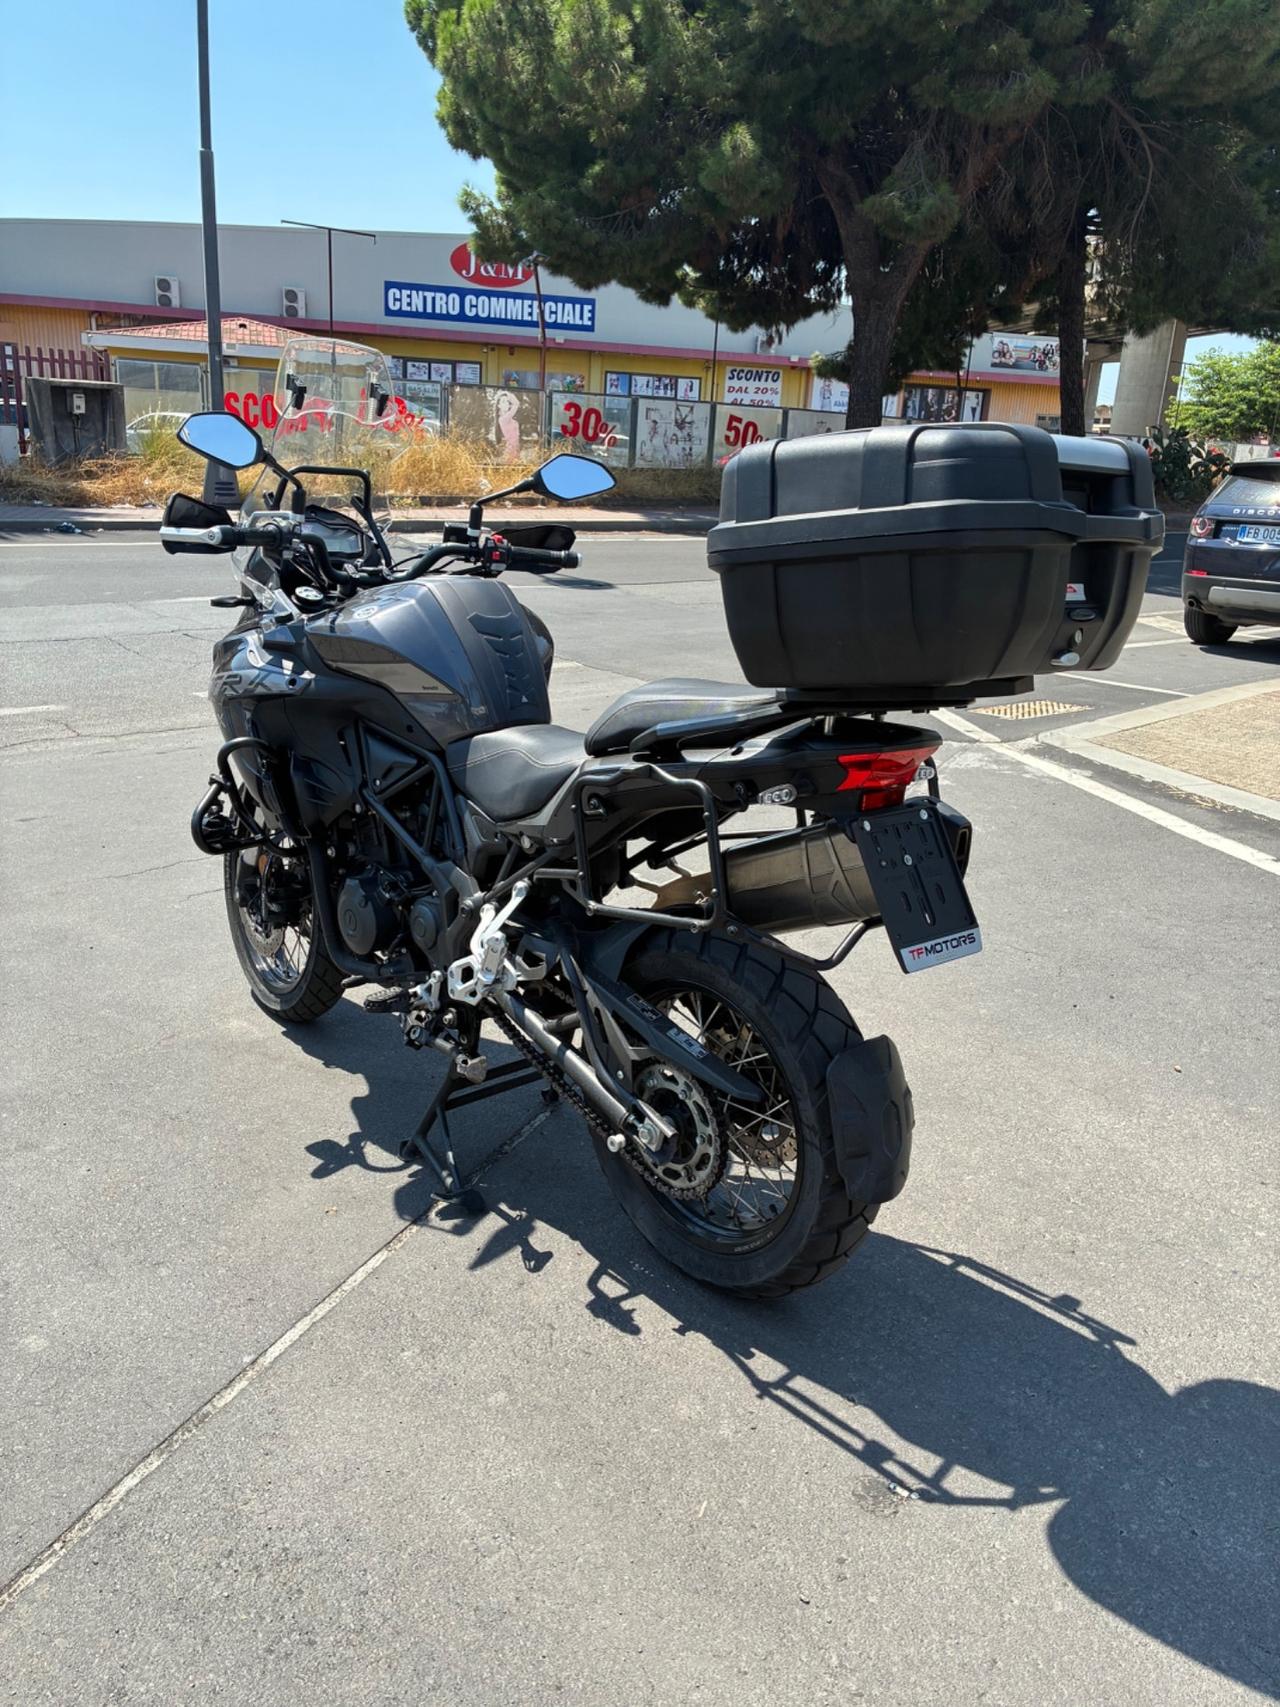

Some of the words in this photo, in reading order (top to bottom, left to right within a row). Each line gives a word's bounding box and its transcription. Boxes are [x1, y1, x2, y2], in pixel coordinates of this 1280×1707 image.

[387, 287, 460, 315] CENTRO
[728, 368, 780, 382] SCONTO
[727, 385, 749, 394] DAL
[753, 387, 779, 395] 20%
[560, 402, 618, 448] 30%
[1247, 527, 1260, 538] FB
[908, 933, 976, 960] TFMOTORS
